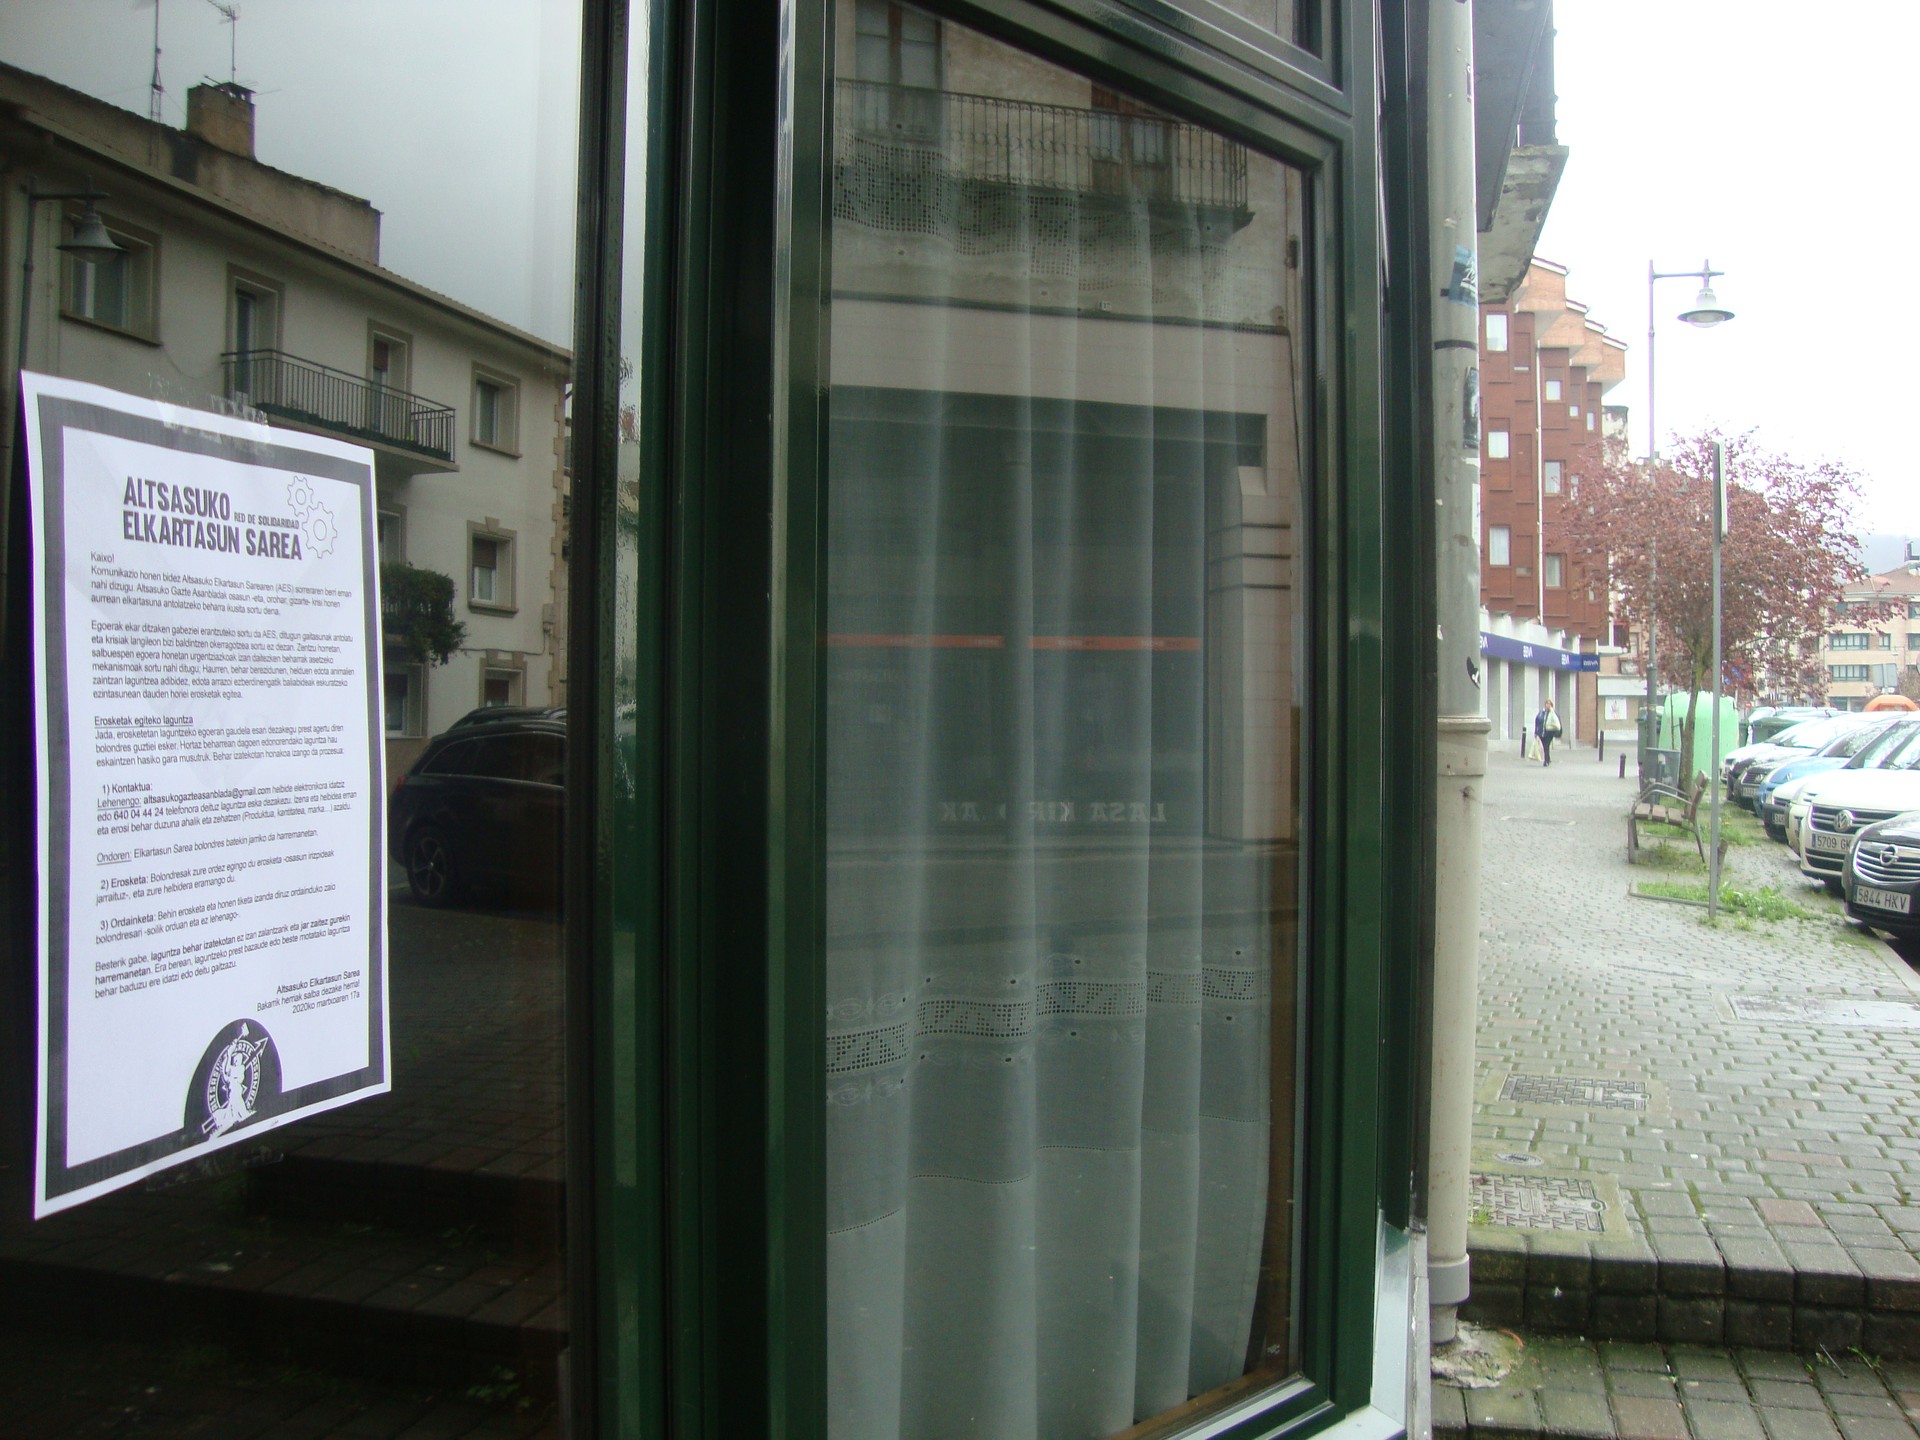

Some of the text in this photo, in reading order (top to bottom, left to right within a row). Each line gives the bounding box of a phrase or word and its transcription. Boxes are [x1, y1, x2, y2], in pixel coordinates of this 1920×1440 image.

[124, 476, 300, 529] ALTSASUKO RED DE SOLIDARIDAD
[123, 510, 302, 560] ELKARTASUN SAREA
[91, 565, 139, 579] Komunikazio
[139, 570, 162, 581] honen
[91, 580, 108, 589] nahi
[91, 595, 121, 604] aurrean
[122, 595, 162, 607] elkartasuna
[91, 620, 124, 632] Egoerak
[125, 622, 140, 632] ekar
[91, 635, 104, 643] eta
[105, 634, 129, 645] krisiak
[130, 636, 162, 647] langileon
[92, 648, 135, 660] salbuespen
[135, 651, 161, 660] egoera
[92, 662, 143, 671] mekanismoak
[92, 675, 124, 685] zaintzan
[124, 676, 159, 687] laguntzea
[93, 689, 142, 698] ezintasunean
[94, 716, 133, 725] Erosketak
[134, 715, 162, 726] egiteko
[116, 729, 159, 739] erosketetan
[95, 743, 132, 753] bolondres
[133, 742, 157, 753] guztiei
[96, 757, 136, 767] eskaintzen
[137, 755, 161, 765] hasiko
[103, 783, 110, 794] 1)
[97, 812, 113, 822] edo
[113, 810, 129, 820] 640
[130, 809, 141, 819] 04
[142, 808, 153, 817] 44
[97, 826, 109, 835] eta
[111, 823, 130, 834] erosi
[130, 822, 152, 832] behar
[1817, 835, 1851, 850] 5709 GK
[101, 880, 110, 892] 2)
[133, 889, 145, 898] eta
[1858, 888, 1907, 911] 5844 HKV
[100, 921, 109, 932] 3)
[95, 928, 143, 944] bolondresari
[95, 957, 126, 972] Besterik
[95, 987, 118, 999] behar
[119, 981, 148, 994] baduzu
